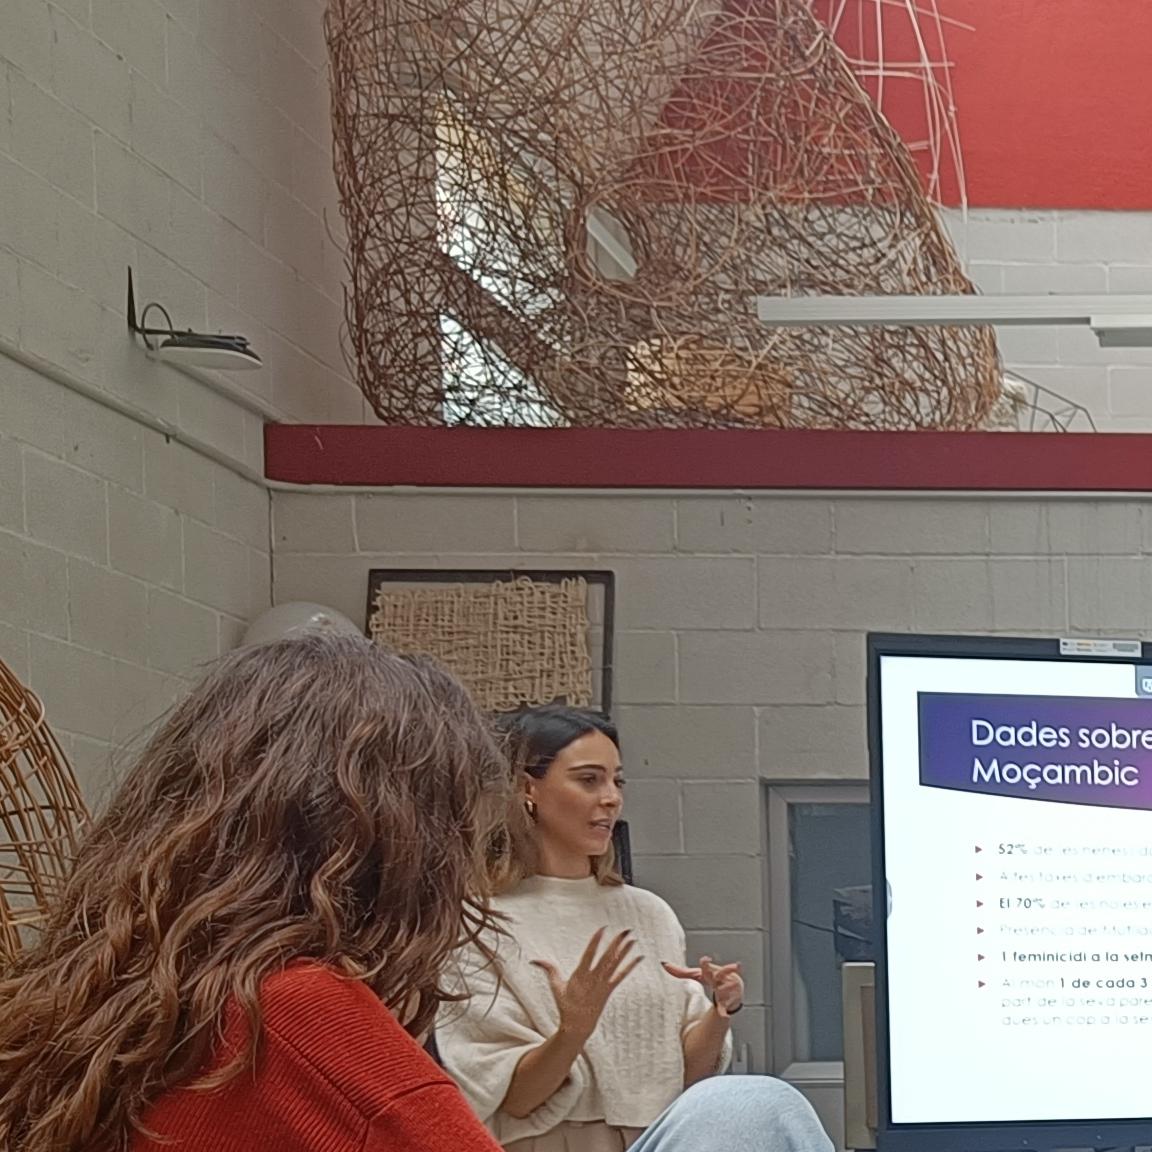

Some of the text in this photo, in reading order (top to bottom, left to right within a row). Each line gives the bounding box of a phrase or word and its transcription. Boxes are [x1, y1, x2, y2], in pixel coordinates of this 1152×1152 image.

[971, 719, 1071, 748] Dades
[971, 757, 1140, 789] Moçambic
[997, 842, 1028, 855] 52%
[999, 896, 1010, 909] El
[1016, 896, 1046, 910] 70%
[1012, 950, 1087, 962] feminicidi
[1091, 953, 1101, 962] a
[1105, 950, 1119, 962] la
[1060, 977, 1065, 989] 1
[1071, 977, 1091, 989] de
[1096, 977, 1135, 989] cada
[1140, 977, 1148, 988] 3
